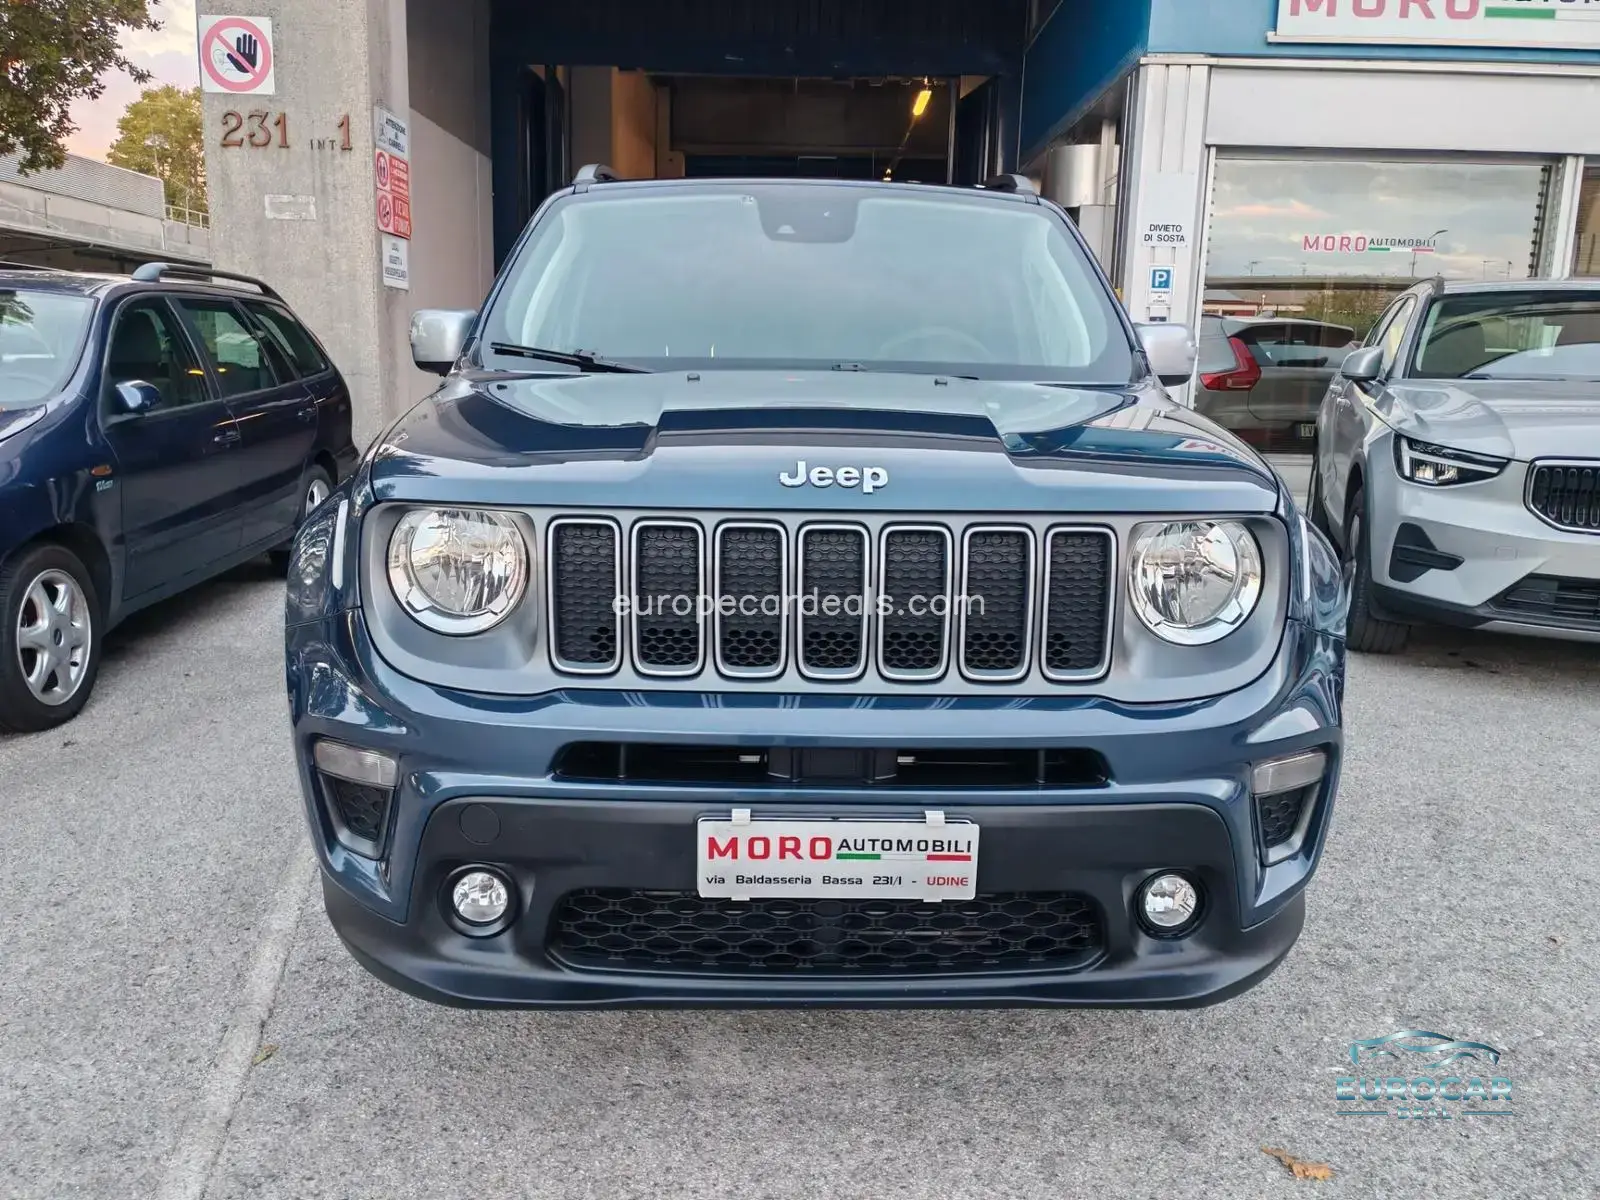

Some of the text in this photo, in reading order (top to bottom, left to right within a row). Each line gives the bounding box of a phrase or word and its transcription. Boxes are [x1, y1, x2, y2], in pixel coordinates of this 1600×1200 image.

[220, 110, 353, 151] 231 INT 1
[1149, 224, 1182, 232] DIVIETO
[1144, 234, 1185, 242] DI SOSTA
[1303, 235, 1436, 252] MORO AUTOMOBILI
[1154, 271, 1168, 287] P
[779, 461, 889, 493] Jeep
[708, 836, 972, 860] MORO AUTOMOBILI
[706, 875, 725, 885] via
[735, 875, 812, 885] Baldasseria
[822, 875, 863, 885] Bassa
[926, 876, 969, 887] UDINE
